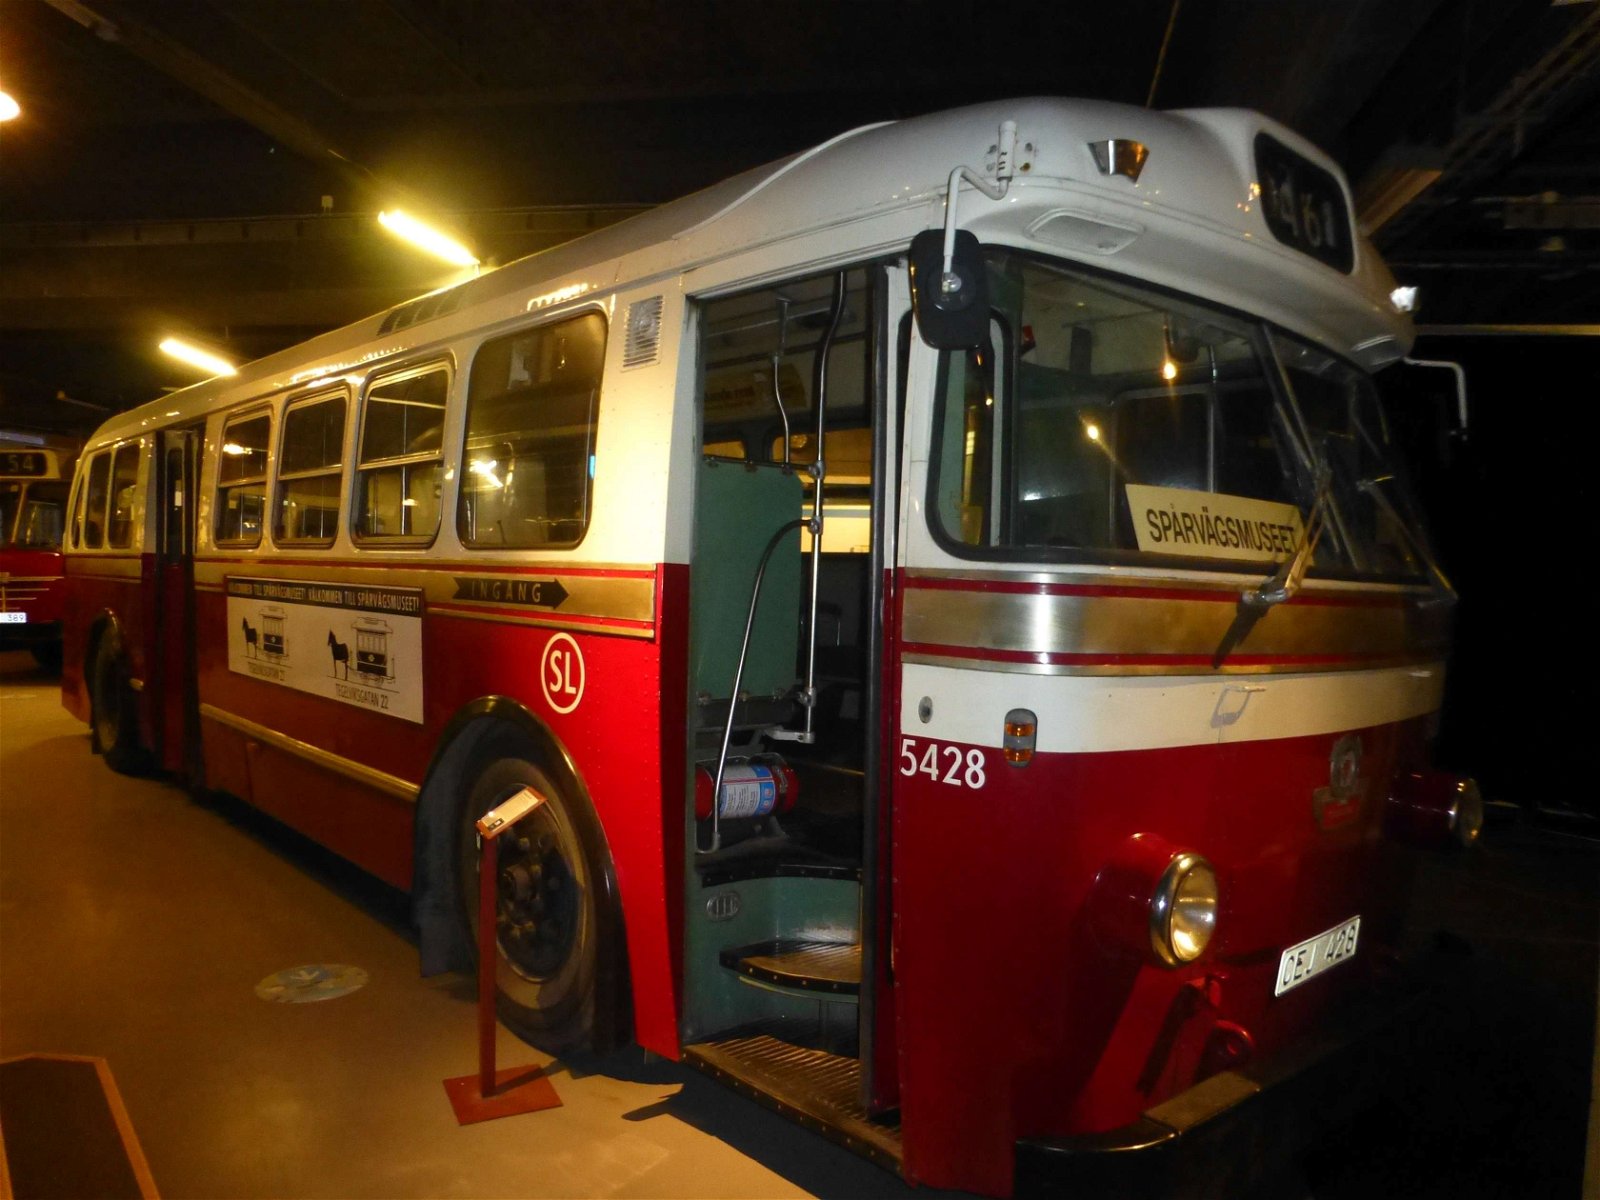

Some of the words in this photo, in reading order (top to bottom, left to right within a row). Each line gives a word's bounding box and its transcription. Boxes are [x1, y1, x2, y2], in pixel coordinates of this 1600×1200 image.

[9, 454, 34, 472] 54
[1146, 503, 1299, 554] SPÅRVÄGSMUSEET
[550, 650, 577, 695] SL
[381, 694, 389, 709] 22
[900, 738, 986, 790] 5428
[1324, 924, 1356, 961] 428
